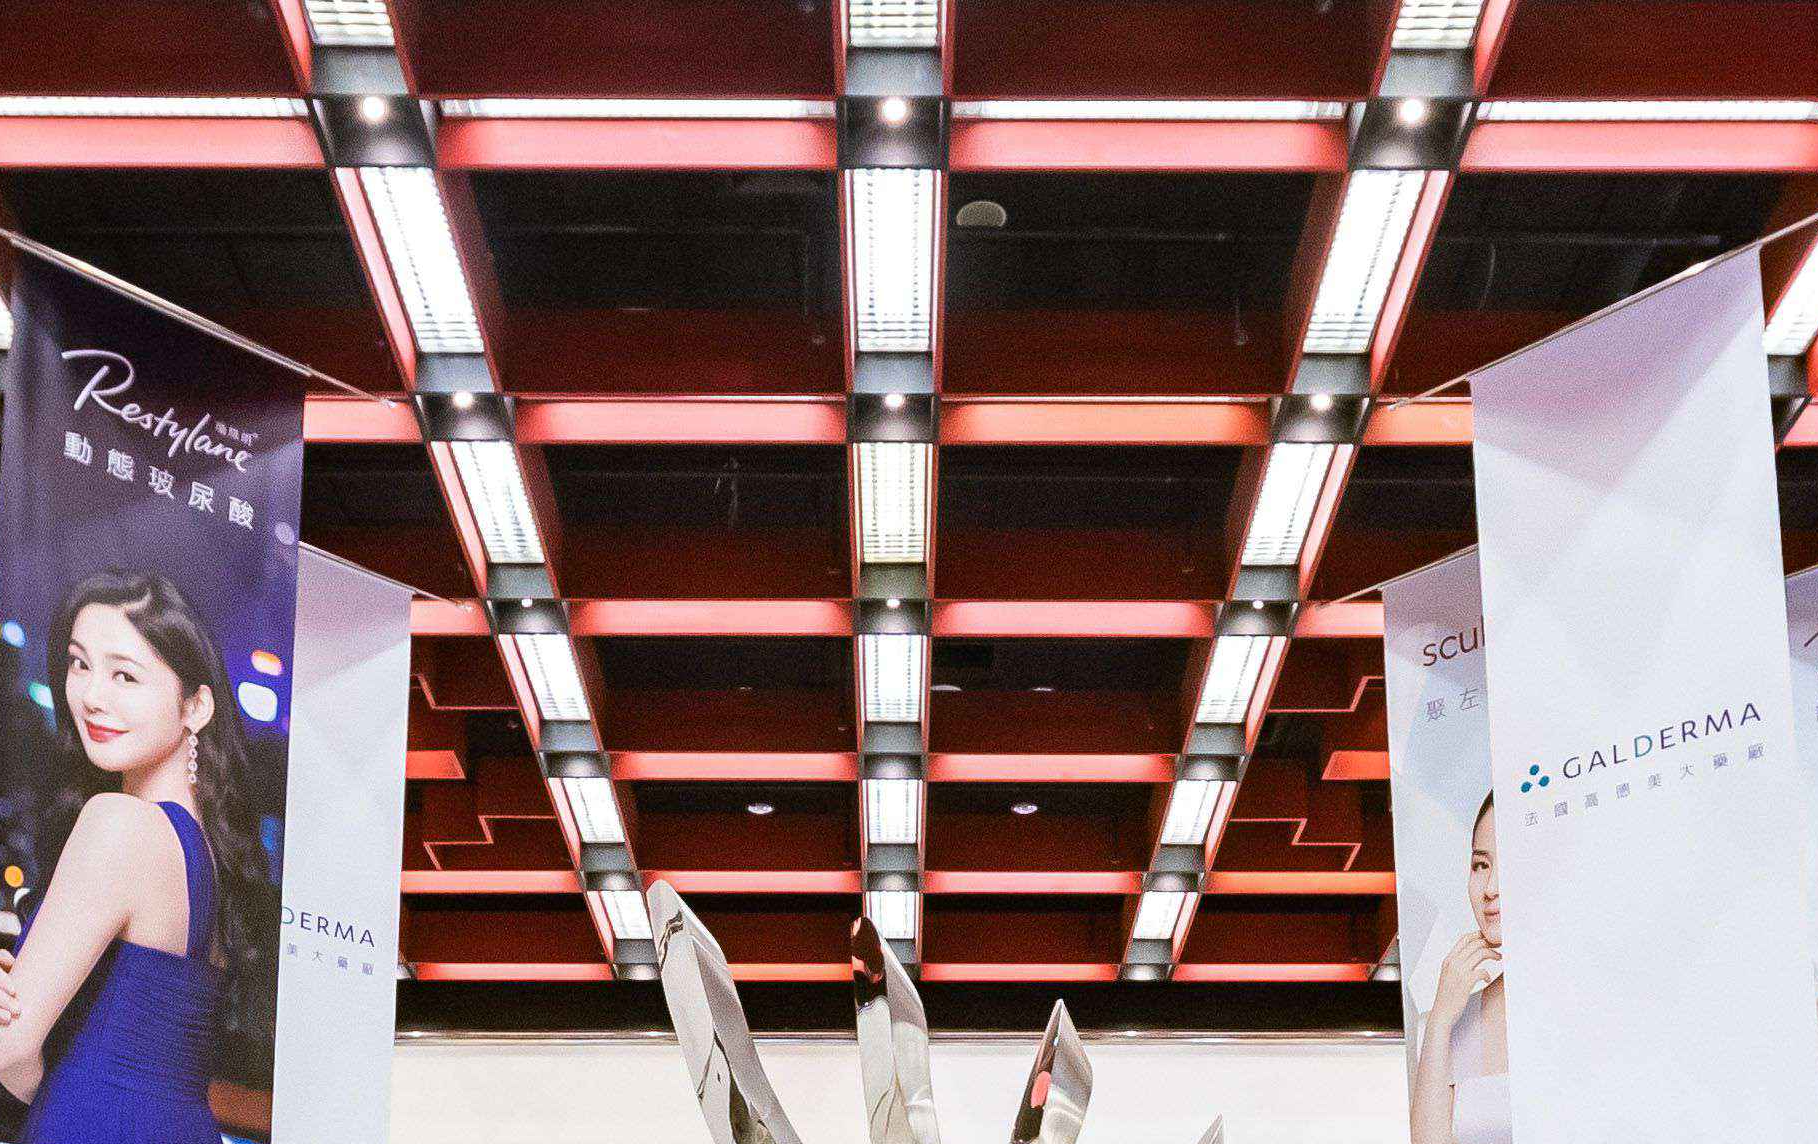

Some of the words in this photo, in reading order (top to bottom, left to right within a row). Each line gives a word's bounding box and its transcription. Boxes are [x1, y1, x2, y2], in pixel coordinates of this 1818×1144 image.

[61, 348, 252, 475] Restylane
[63, 430, 255, 531] 動態玻尿酸
[1562, 701, 1763, 780] GALDERMA
